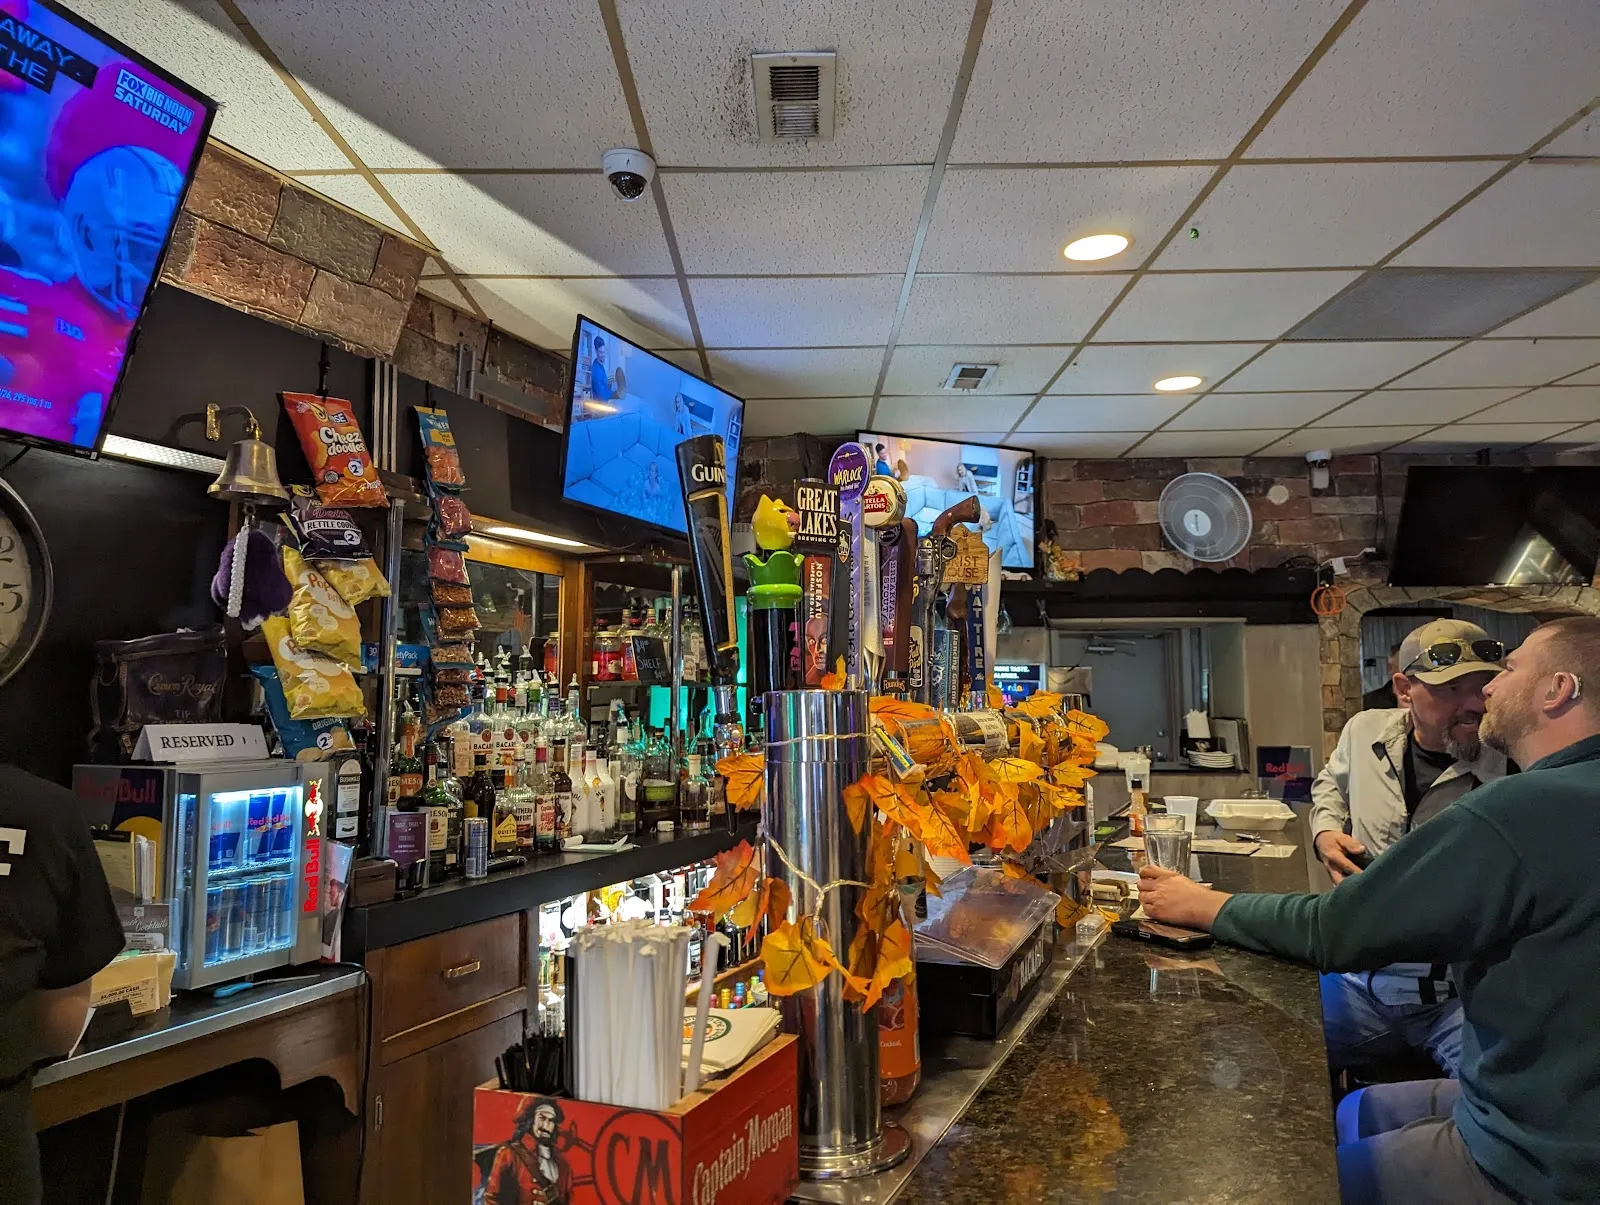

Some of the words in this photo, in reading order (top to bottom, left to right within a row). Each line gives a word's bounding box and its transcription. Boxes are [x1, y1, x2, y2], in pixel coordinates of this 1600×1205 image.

[114, 86, 188, 135] SATURDAY
[119, 72, 146, 99] FOX
[145, 86, 165, 108] BIG
[163, 97, 193, 124] NOON
[319, 426, 363, 444] Cheez
[327, 442, 366, 456] doodles
[833, 465, 864, 486] WARLOCK
[797, 486, 838, 514] GREAT
[864, 496, 886, 504] TELLA
[307, 521, 334, 531] KETTLE
[798, 510, 838, 538] LAKES
[797, 534, 827, 543] BREWING
[945, 567, 979, 578] OUSE
[815, 562, 823, 620] NOSFERATU
[888, 560, 897, 627] BREAKFAST
[972, 584, 982, 618] FAT
[974, 623, 984, 669] TIRE
[883, 679, 906, 692] Founders
[160, 734, 235, 749] RESERVED
[305, 838, 320, 874] Bull
[303, 875, 319, 912] Red
[692, 1132, 752, 1205] Captain
[744, 1103, 793, 1180] Morgan
